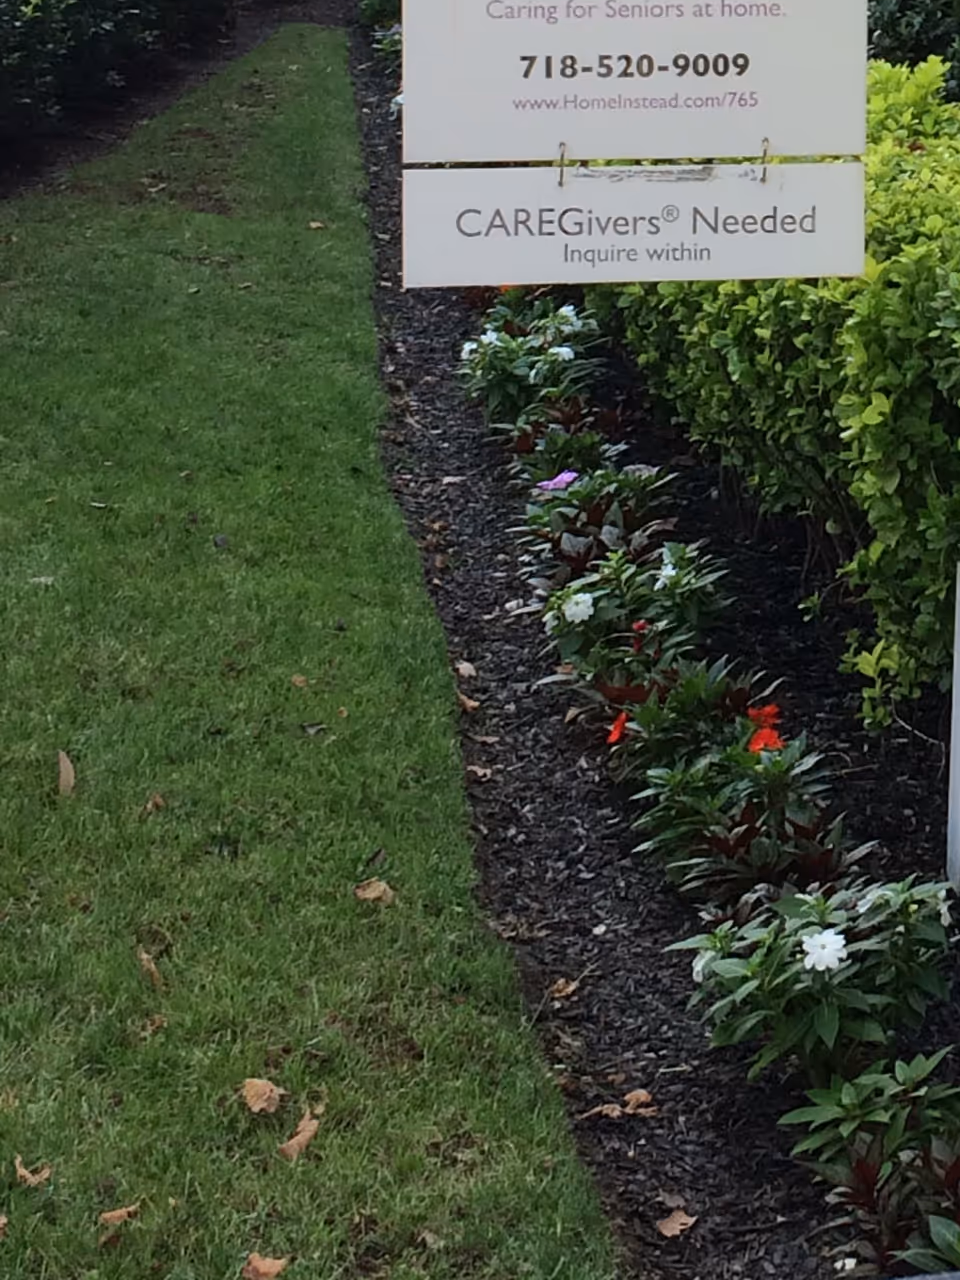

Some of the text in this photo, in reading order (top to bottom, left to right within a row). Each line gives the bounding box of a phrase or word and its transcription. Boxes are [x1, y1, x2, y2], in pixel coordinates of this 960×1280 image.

[485, 0, 559, 25] Caring
[692, 1, 714, 17] at
[519, 53, 751, 79] 718-520-9009
[512, 91, 760, 111] www.HomeInstead.com/765
[692, 205, 817, 234] Needed
[564, 242, 711, 268] Inquire within
